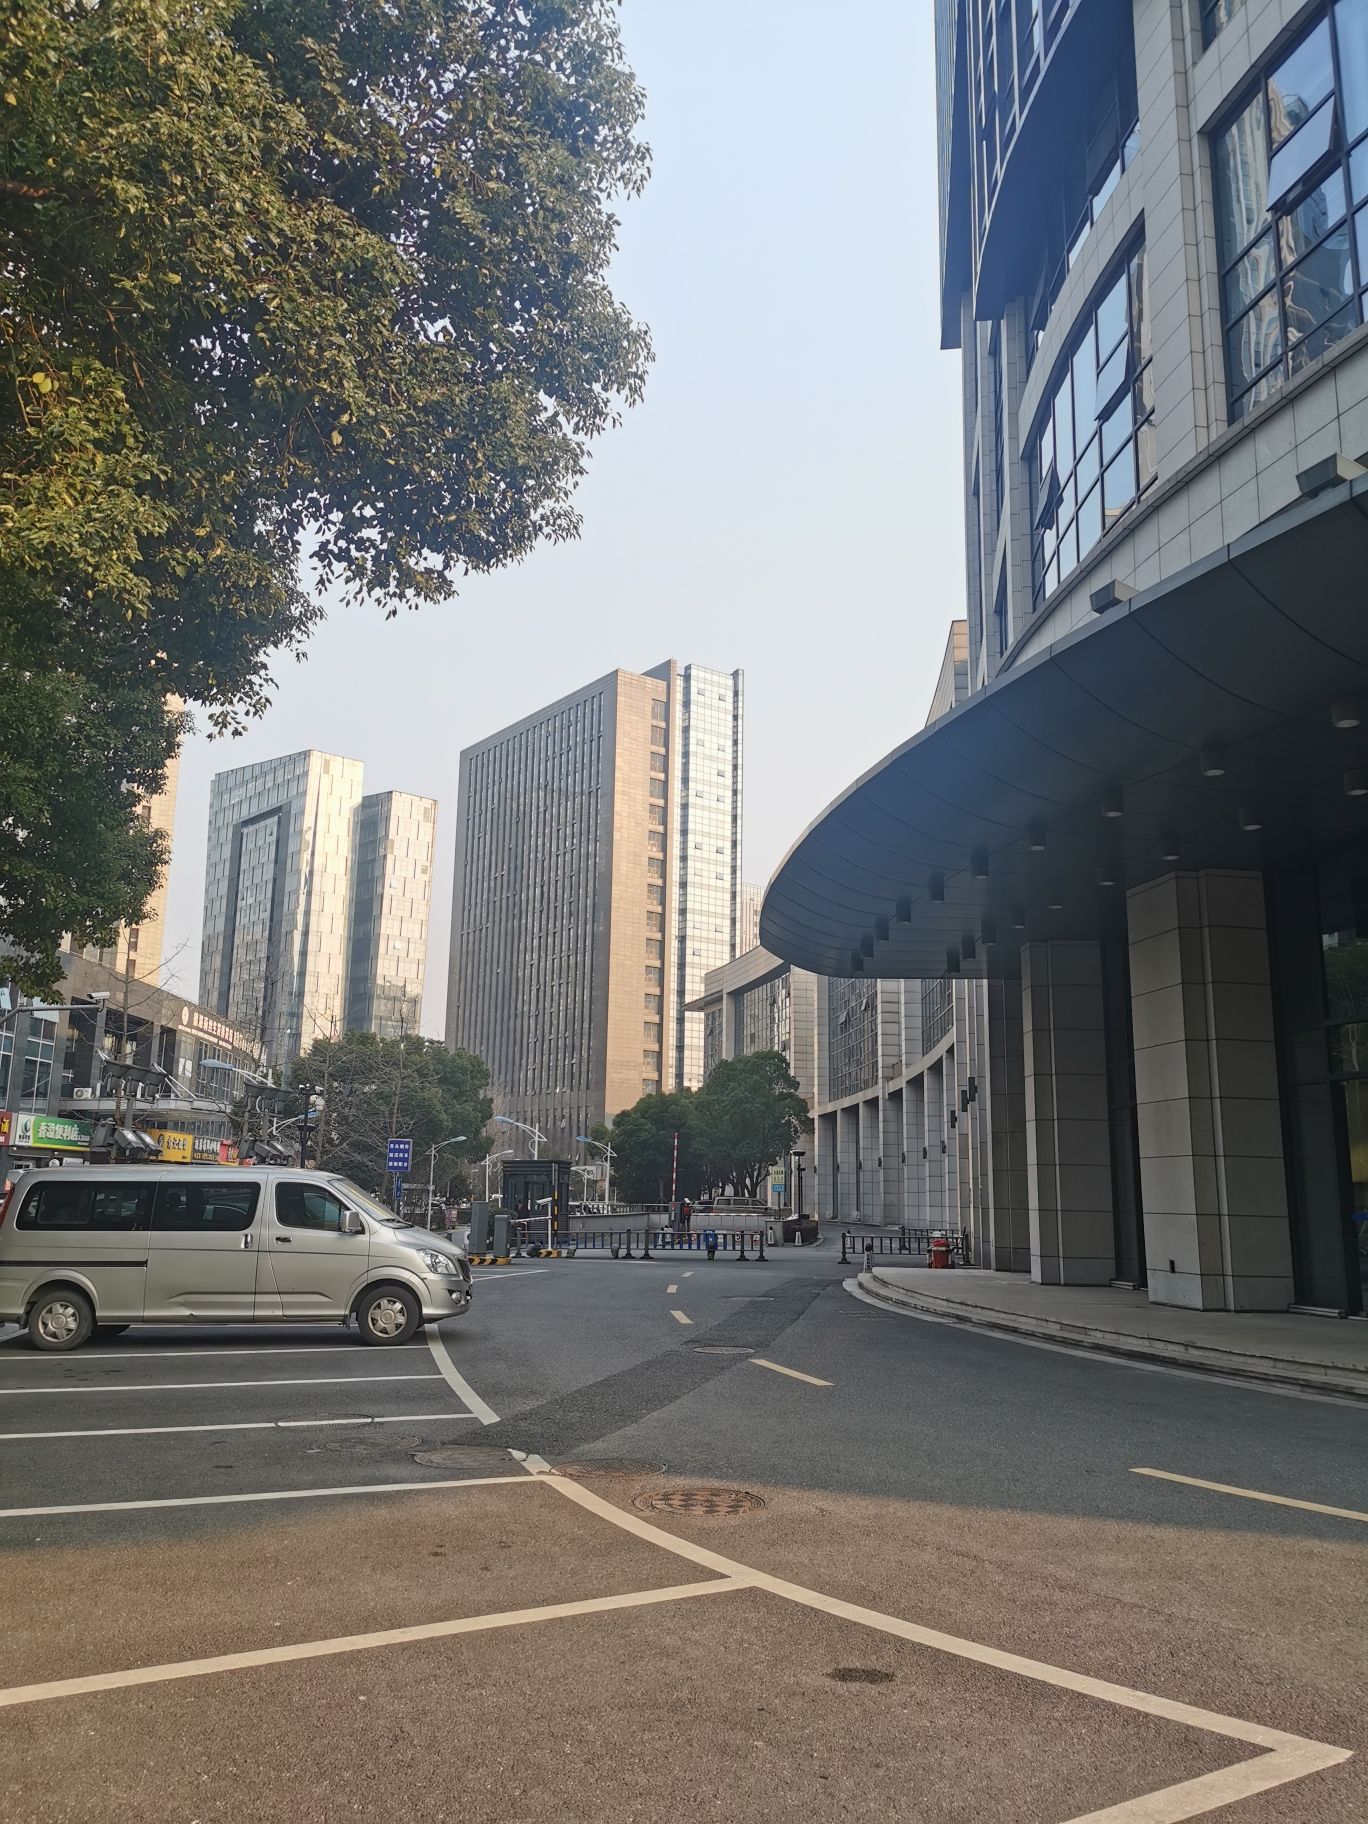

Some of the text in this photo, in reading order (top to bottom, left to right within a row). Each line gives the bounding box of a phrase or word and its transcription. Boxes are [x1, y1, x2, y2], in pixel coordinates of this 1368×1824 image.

[38, 1122, 79, 1141] 香溢便利店
